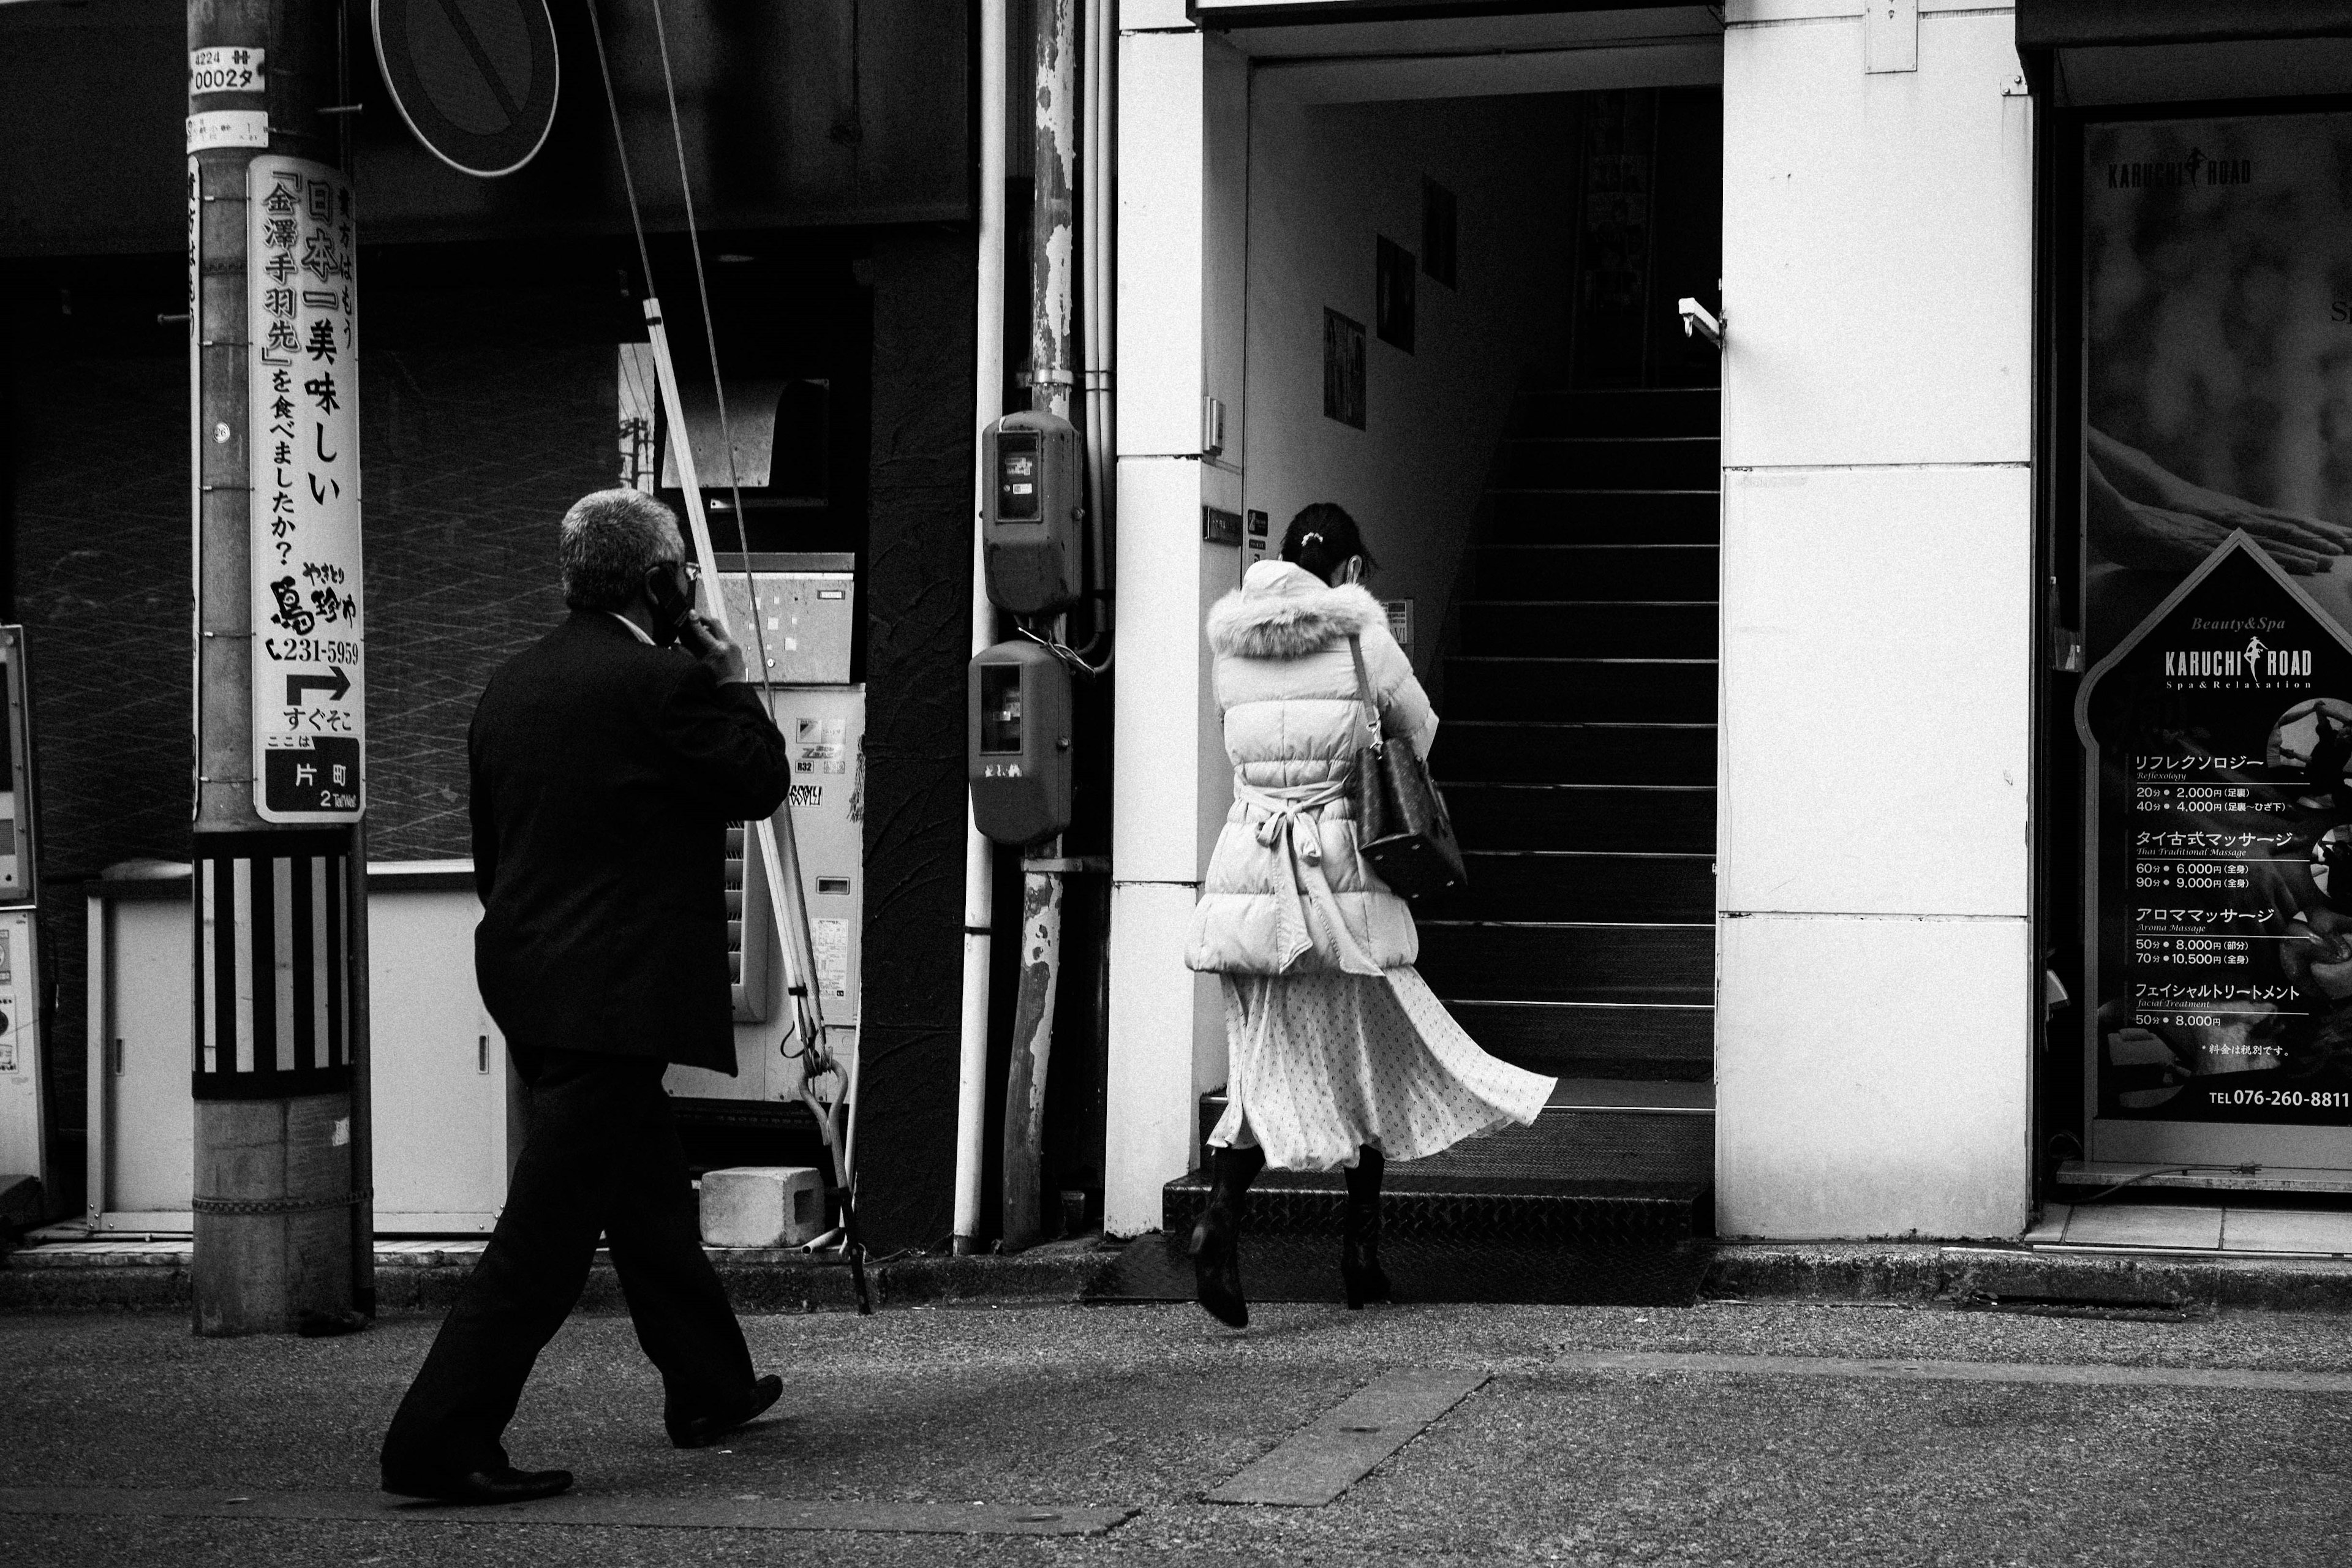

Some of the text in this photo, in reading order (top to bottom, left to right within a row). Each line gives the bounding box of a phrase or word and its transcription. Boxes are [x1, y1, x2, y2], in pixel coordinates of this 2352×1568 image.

[2108, 159, 2252, 189] KARUCHI ROAD
[303, 181, 341, 505] 日本一美味しい
[2192, 616, 2286, 633] Beauty&Spa
[283, 638, 359, 665] 231-5959
[2165, 650, 2312, 676] KARUCHI ROAD
[283, 707, 352, 733] すぐそこ
[268, 734, 311, 748] ここは
[2136, 755, 2264, 771] リフレクソロジー
[295, 763, 347, 787] 片町
[2136, 771, 2187, 781] Reflexology
[2136, 786, 2161, 798] 20分
[2136, 801, 2162, 812] 40分
[2136, 831, 2293, 848] タイ古式マッサージ
[2158, 848, 2209, 856] Traditional
[2210, 848, 2246, 858] Massage
[2136, 862, 2160, 874] 60分
[2136, 876, 2160, 888] 90分
[2136, 908, 2275, 923] アロママッサージ
[2136, 924, 2206, 935] Aroma Massage
[2136, 938, 2160, 949] 50分
[2135, 952, 2160, 963] 70分
[2135, 983, 2300, 1002] フェイシャルトリートメント
[2135, 1014, 2221, 1027] 50分 8,000円
[2209, 1089, 2349, 1107] TEL 076-260-8811
